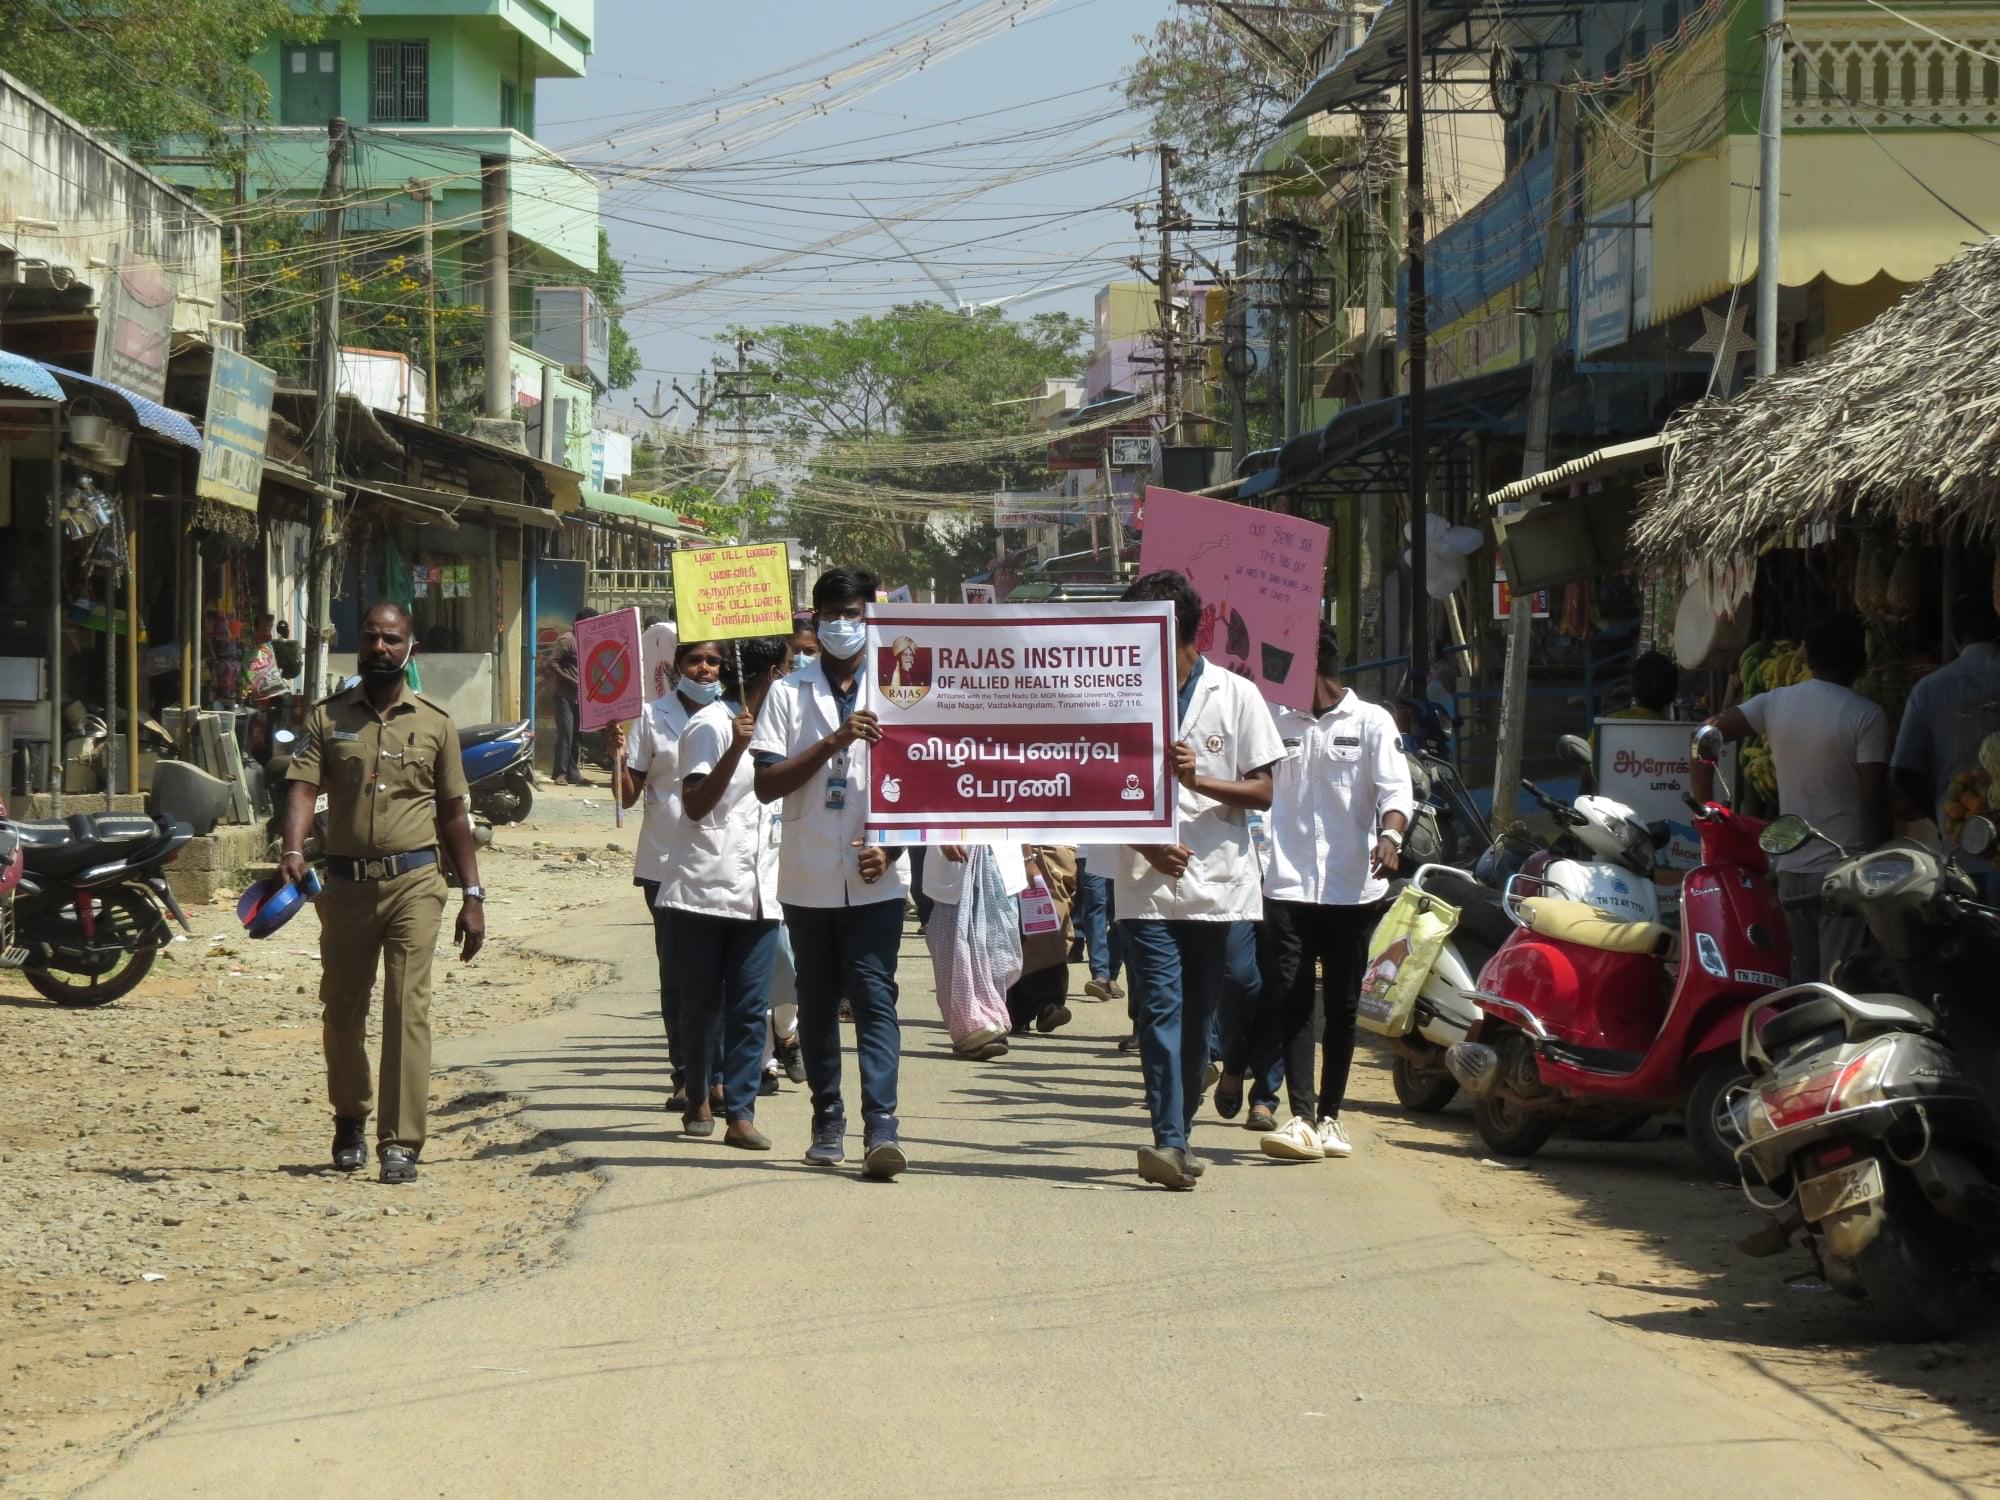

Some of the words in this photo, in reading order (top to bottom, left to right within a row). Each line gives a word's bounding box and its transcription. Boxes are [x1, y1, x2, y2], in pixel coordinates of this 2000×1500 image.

[938, 647, 1015, 669] RAJAS
[1024, 645, 1142, 669] INSTITUTE
[937, 675, 956, 689] OF
[960, 675, 1010, 689] ALLIED
[1015, 674, 1069, 689] HEALTH
[1073, 673, 1143, 688] SCIENCES
[888, 689, 921, 699] RAJAS
[967, 692, 980, 700] with
[981, 692, 992, 700] the
[993, 692, 1010, 700] Tamil
[937, 701, 956, 710] Raja
[958, 701, 984, 710] Nagar,
[1108, 700, 1123, 708] 627
[907, 736, 1120, 768] விழிப்புணர்வு
[1613, 749, 1689, 778] ஆரோக்
[956, 773, 1071, 803] பேரணி
[1650, 779, 1681, 791] பால்
